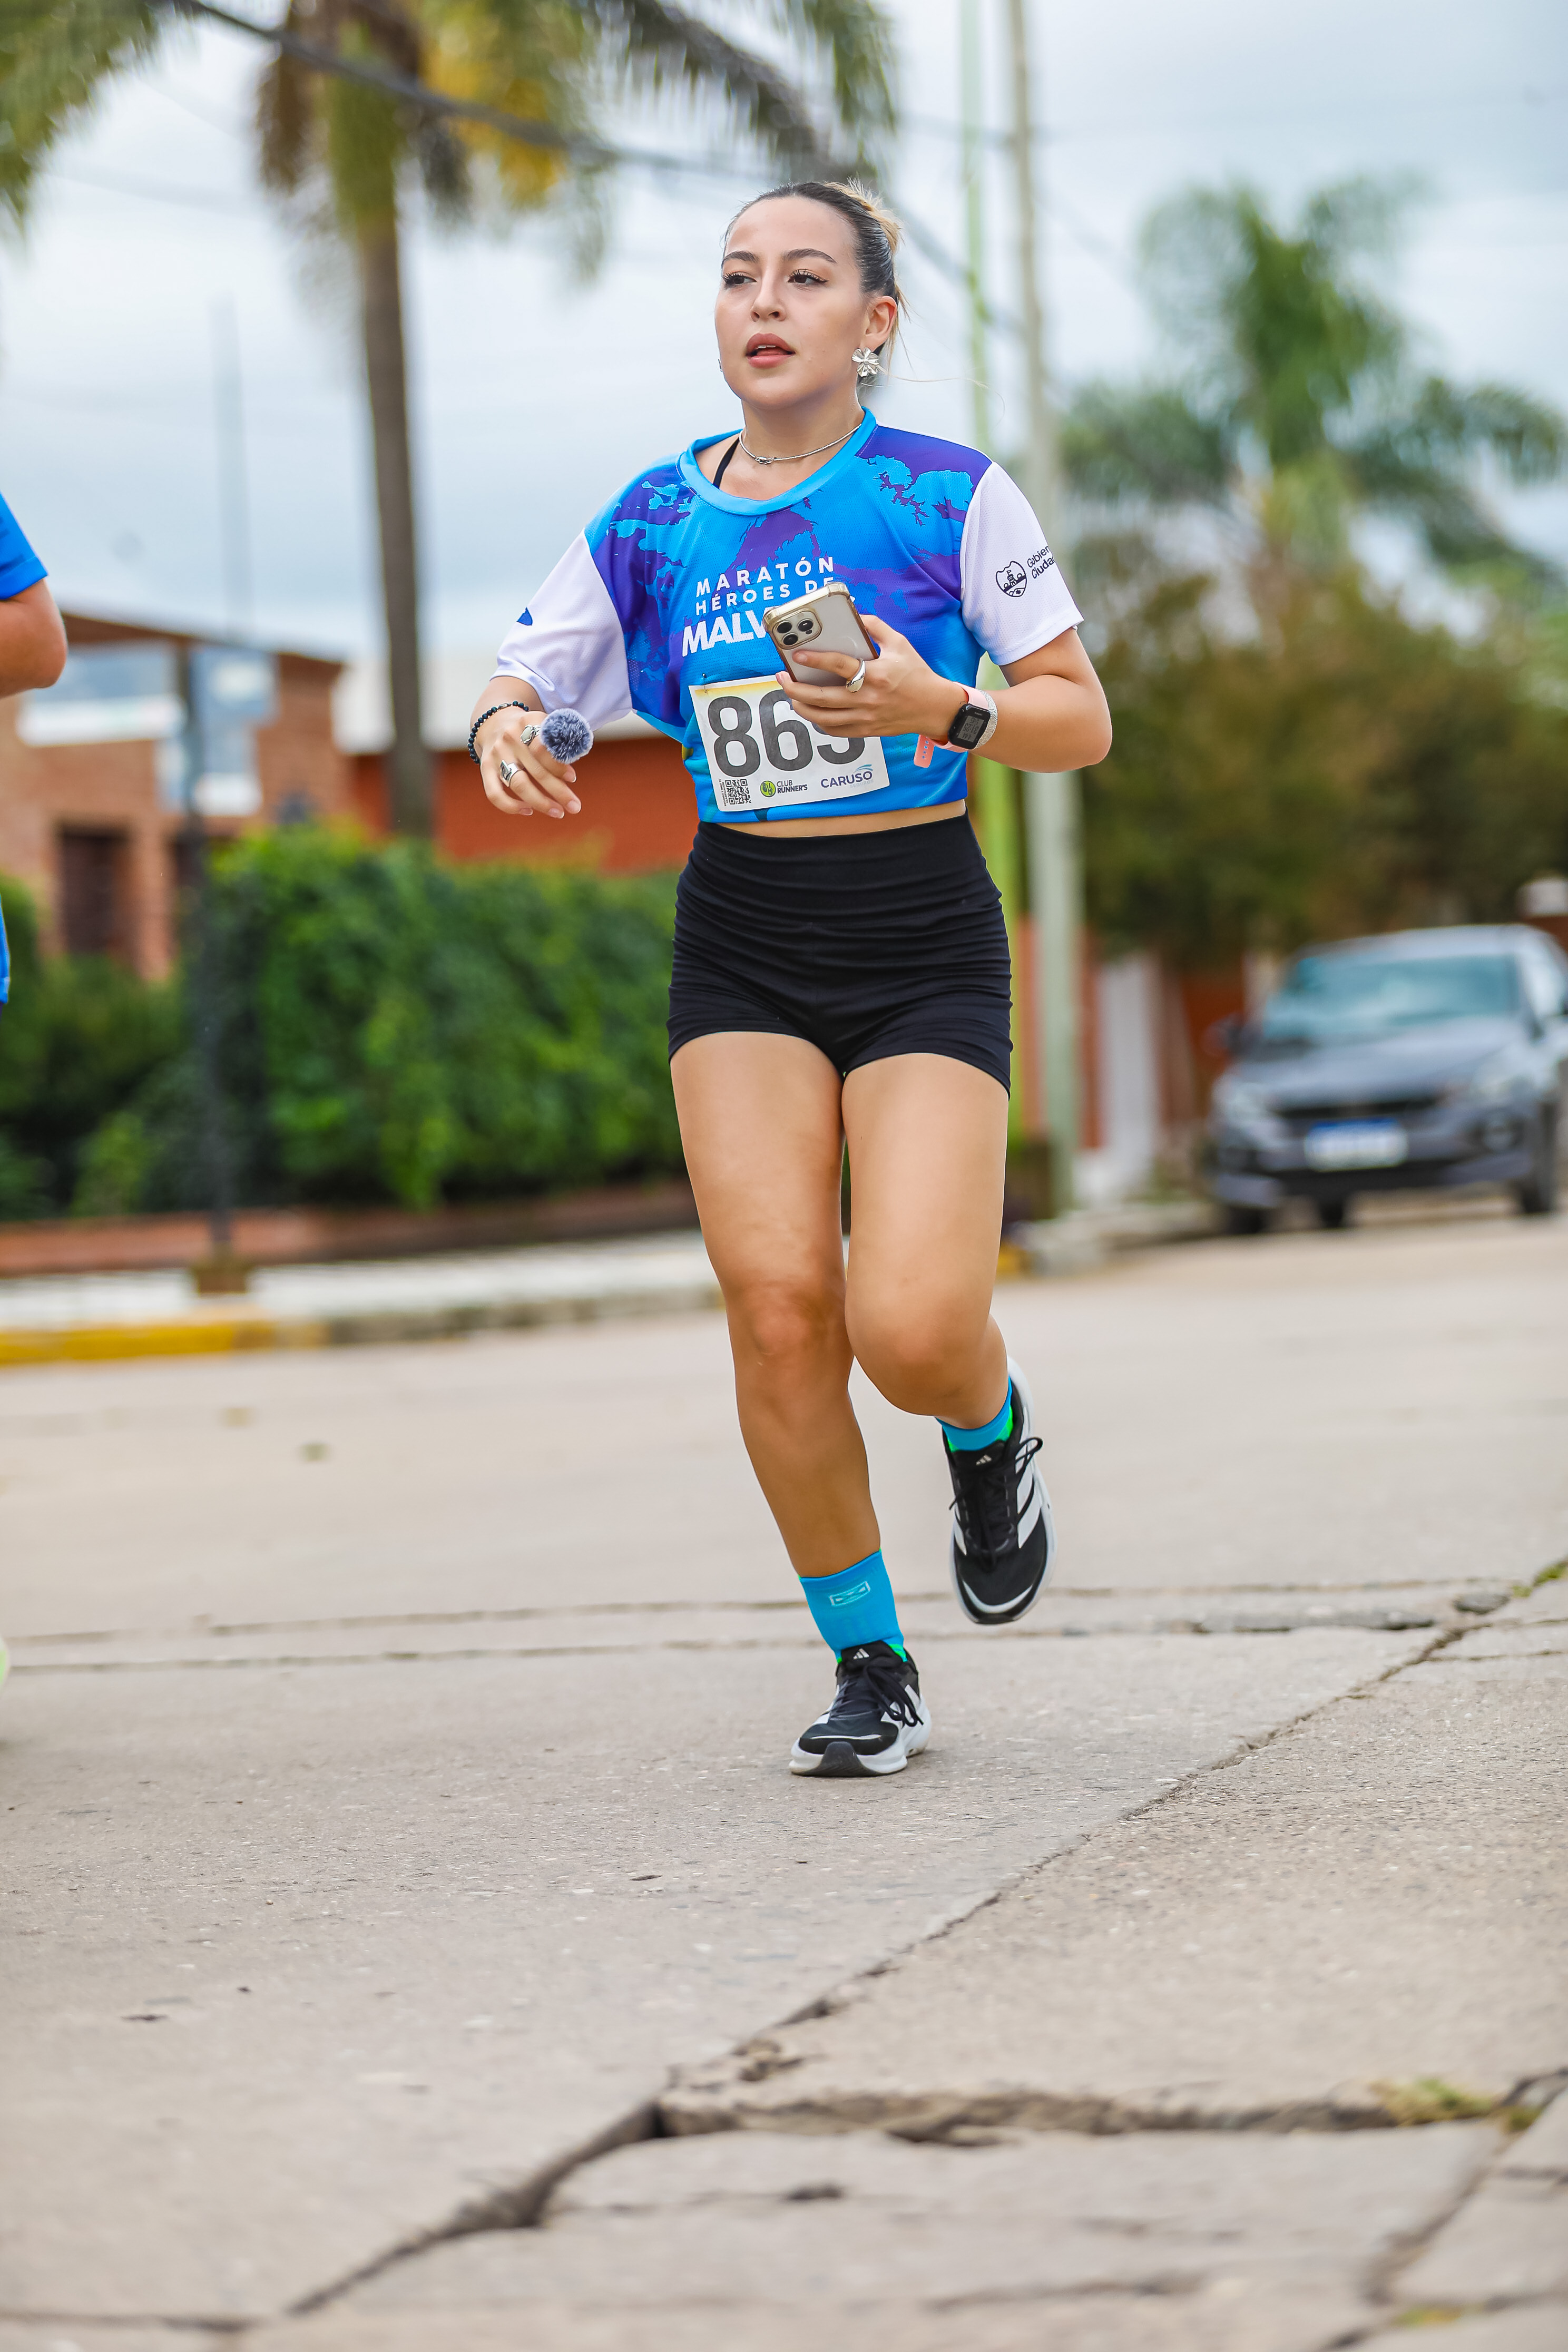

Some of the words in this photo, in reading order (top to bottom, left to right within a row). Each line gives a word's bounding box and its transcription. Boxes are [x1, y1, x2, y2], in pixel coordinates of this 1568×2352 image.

[696, 556, 834, 597] MARATÓN
[1032, 556, 1055, 579] Ciuda
[695, 583, 790, 616] HÉROES
[805, 576, 834, 595] DE
[777, 784, 808, 794] RUNNER'S
[820, 771, 873, 788] CARUSO
[849, 779, 874, 788] SEGUROS
